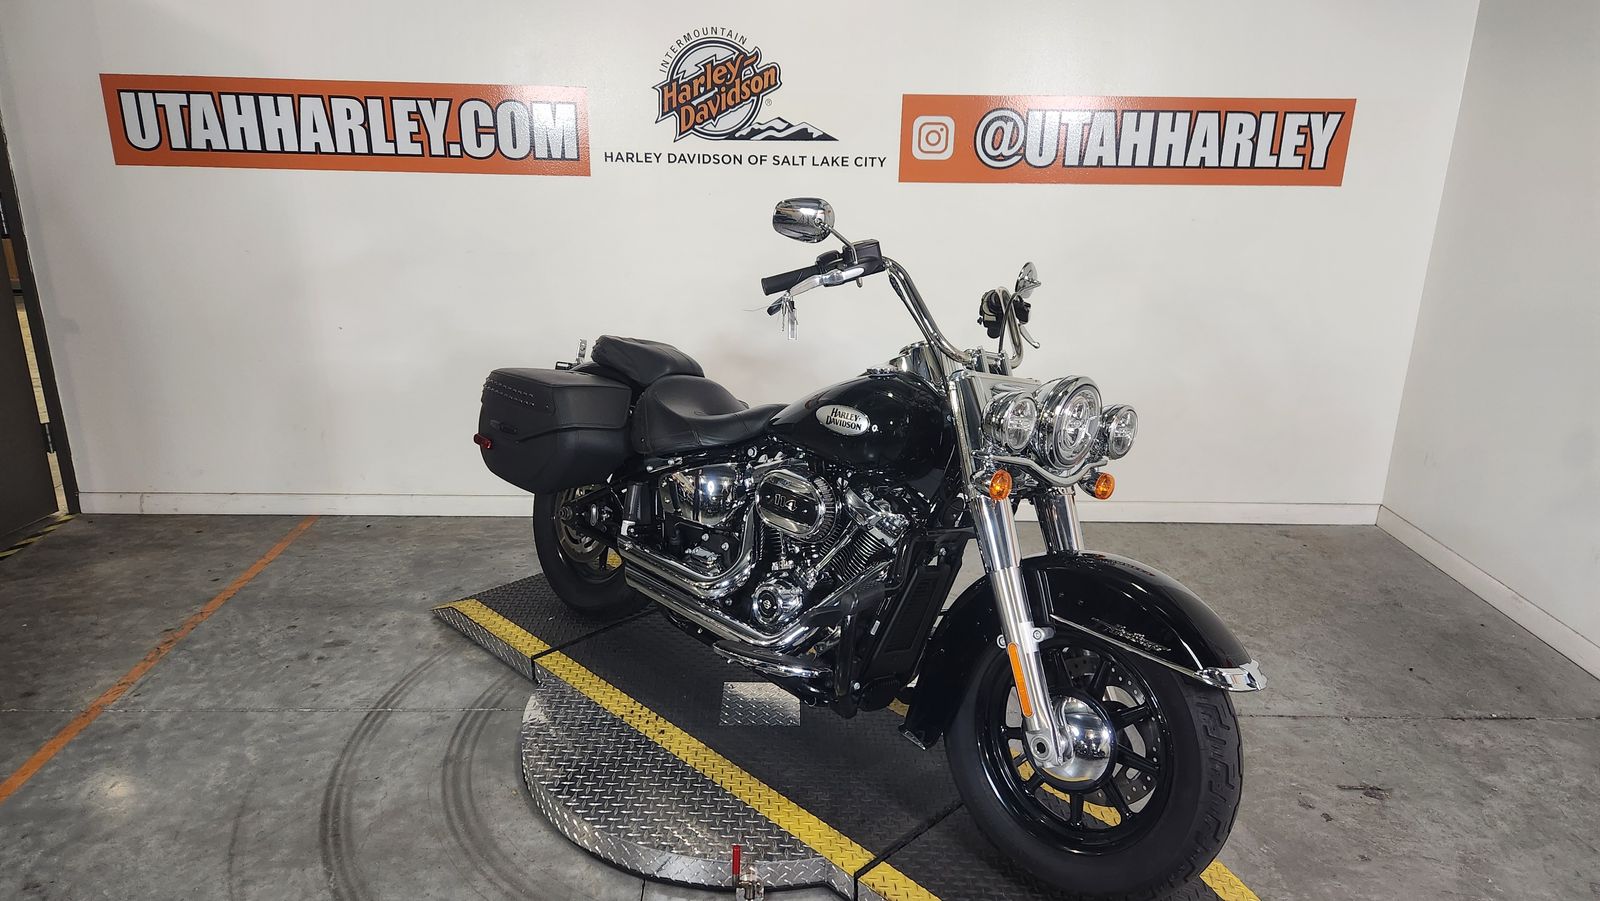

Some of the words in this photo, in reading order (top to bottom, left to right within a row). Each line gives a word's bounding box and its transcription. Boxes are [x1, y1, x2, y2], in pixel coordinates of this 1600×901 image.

[659, 26, 748, 73] INTERMOUNTAIN
[679, 65, 778, 134] Davidson
[117, 88, 580, 162] UTAHHARLEY.COM
[974, 107, 1346, 170] @UTAHHARLEY
[604, 151, 663, 164] HARLEY
[667, 152, 744, 166] DAVIDSON
[747, 153, 769, 166] OF
[772, 154, 808, 167] SALT
[812, 155, 850, 168] LAKE
[854, 156, 888, 169] CITY
[826, 415, 863, 431] DAVIDSON
[774, 493, 798, 512] 114
